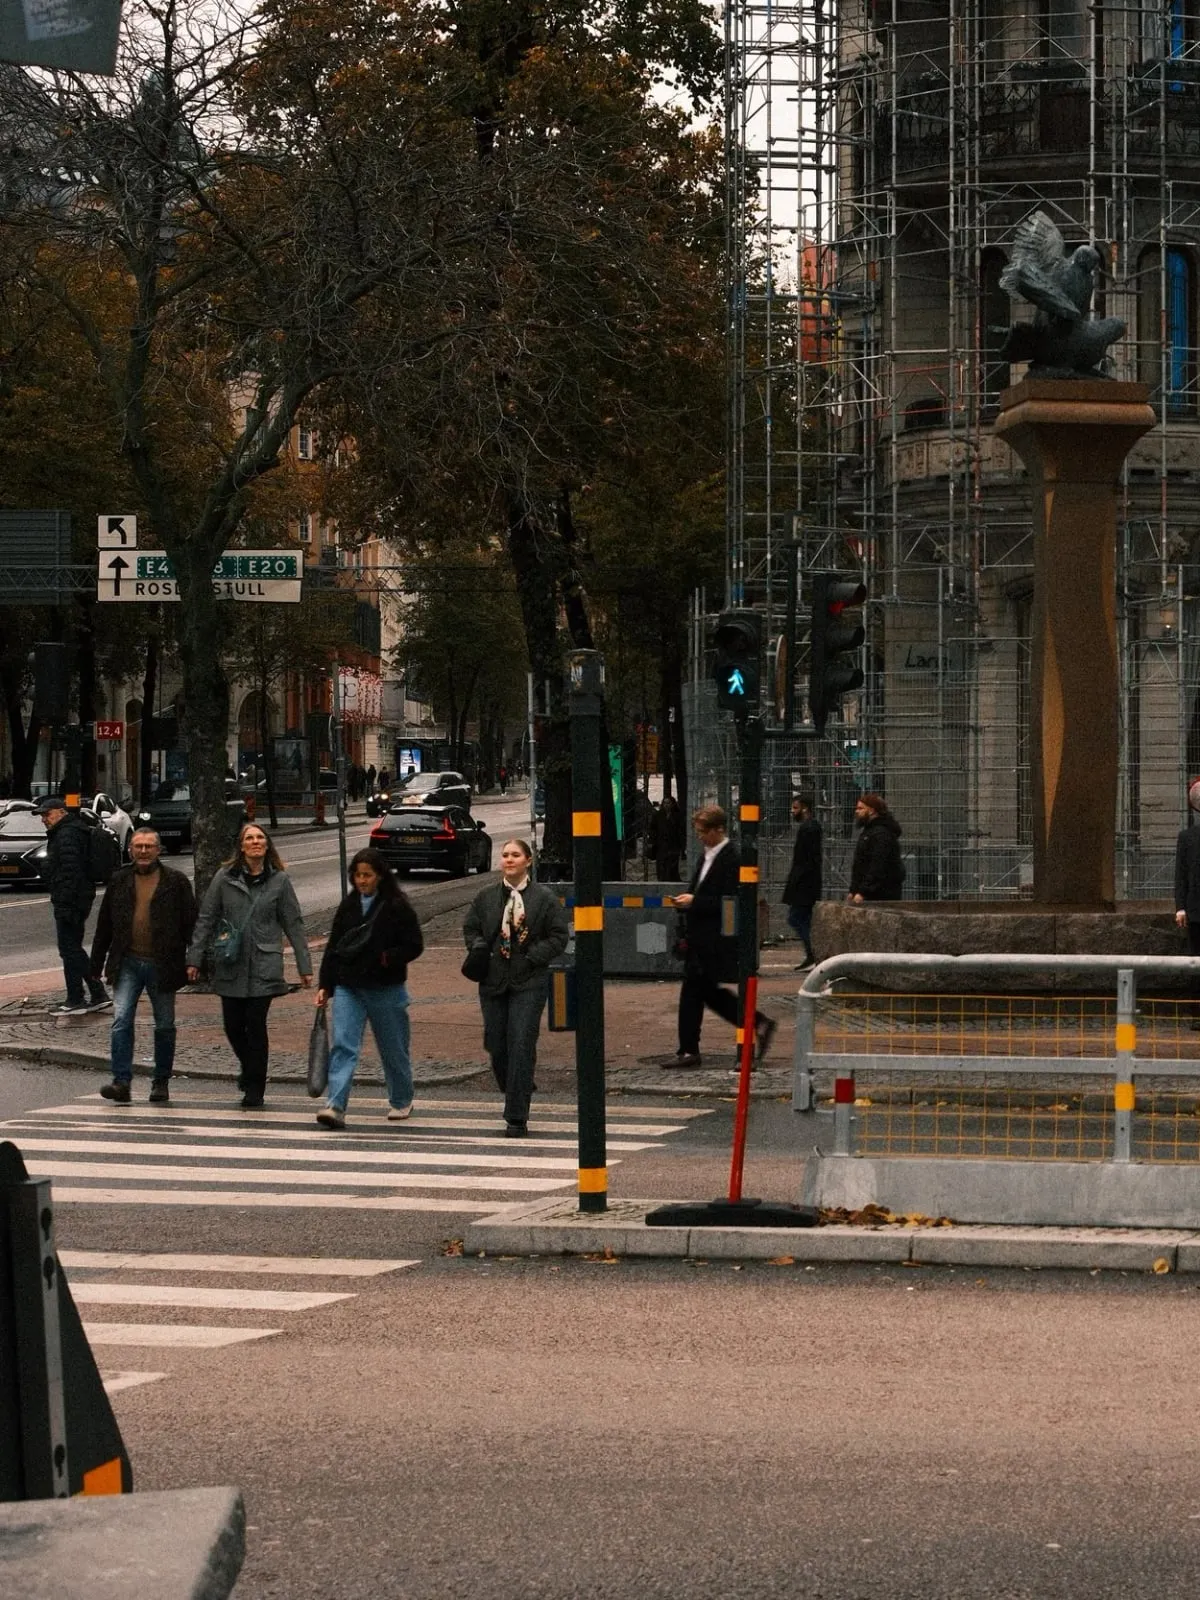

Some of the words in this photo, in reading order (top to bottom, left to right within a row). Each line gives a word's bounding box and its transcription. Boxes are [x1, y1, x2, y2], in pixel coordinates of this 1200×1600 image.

[146, 560, 169, 574] E4
[249, 560, 287, 573] E20
[136, 582, 265, 596] ROSLSTULL
[97, 726, 121, 737] 12,4
